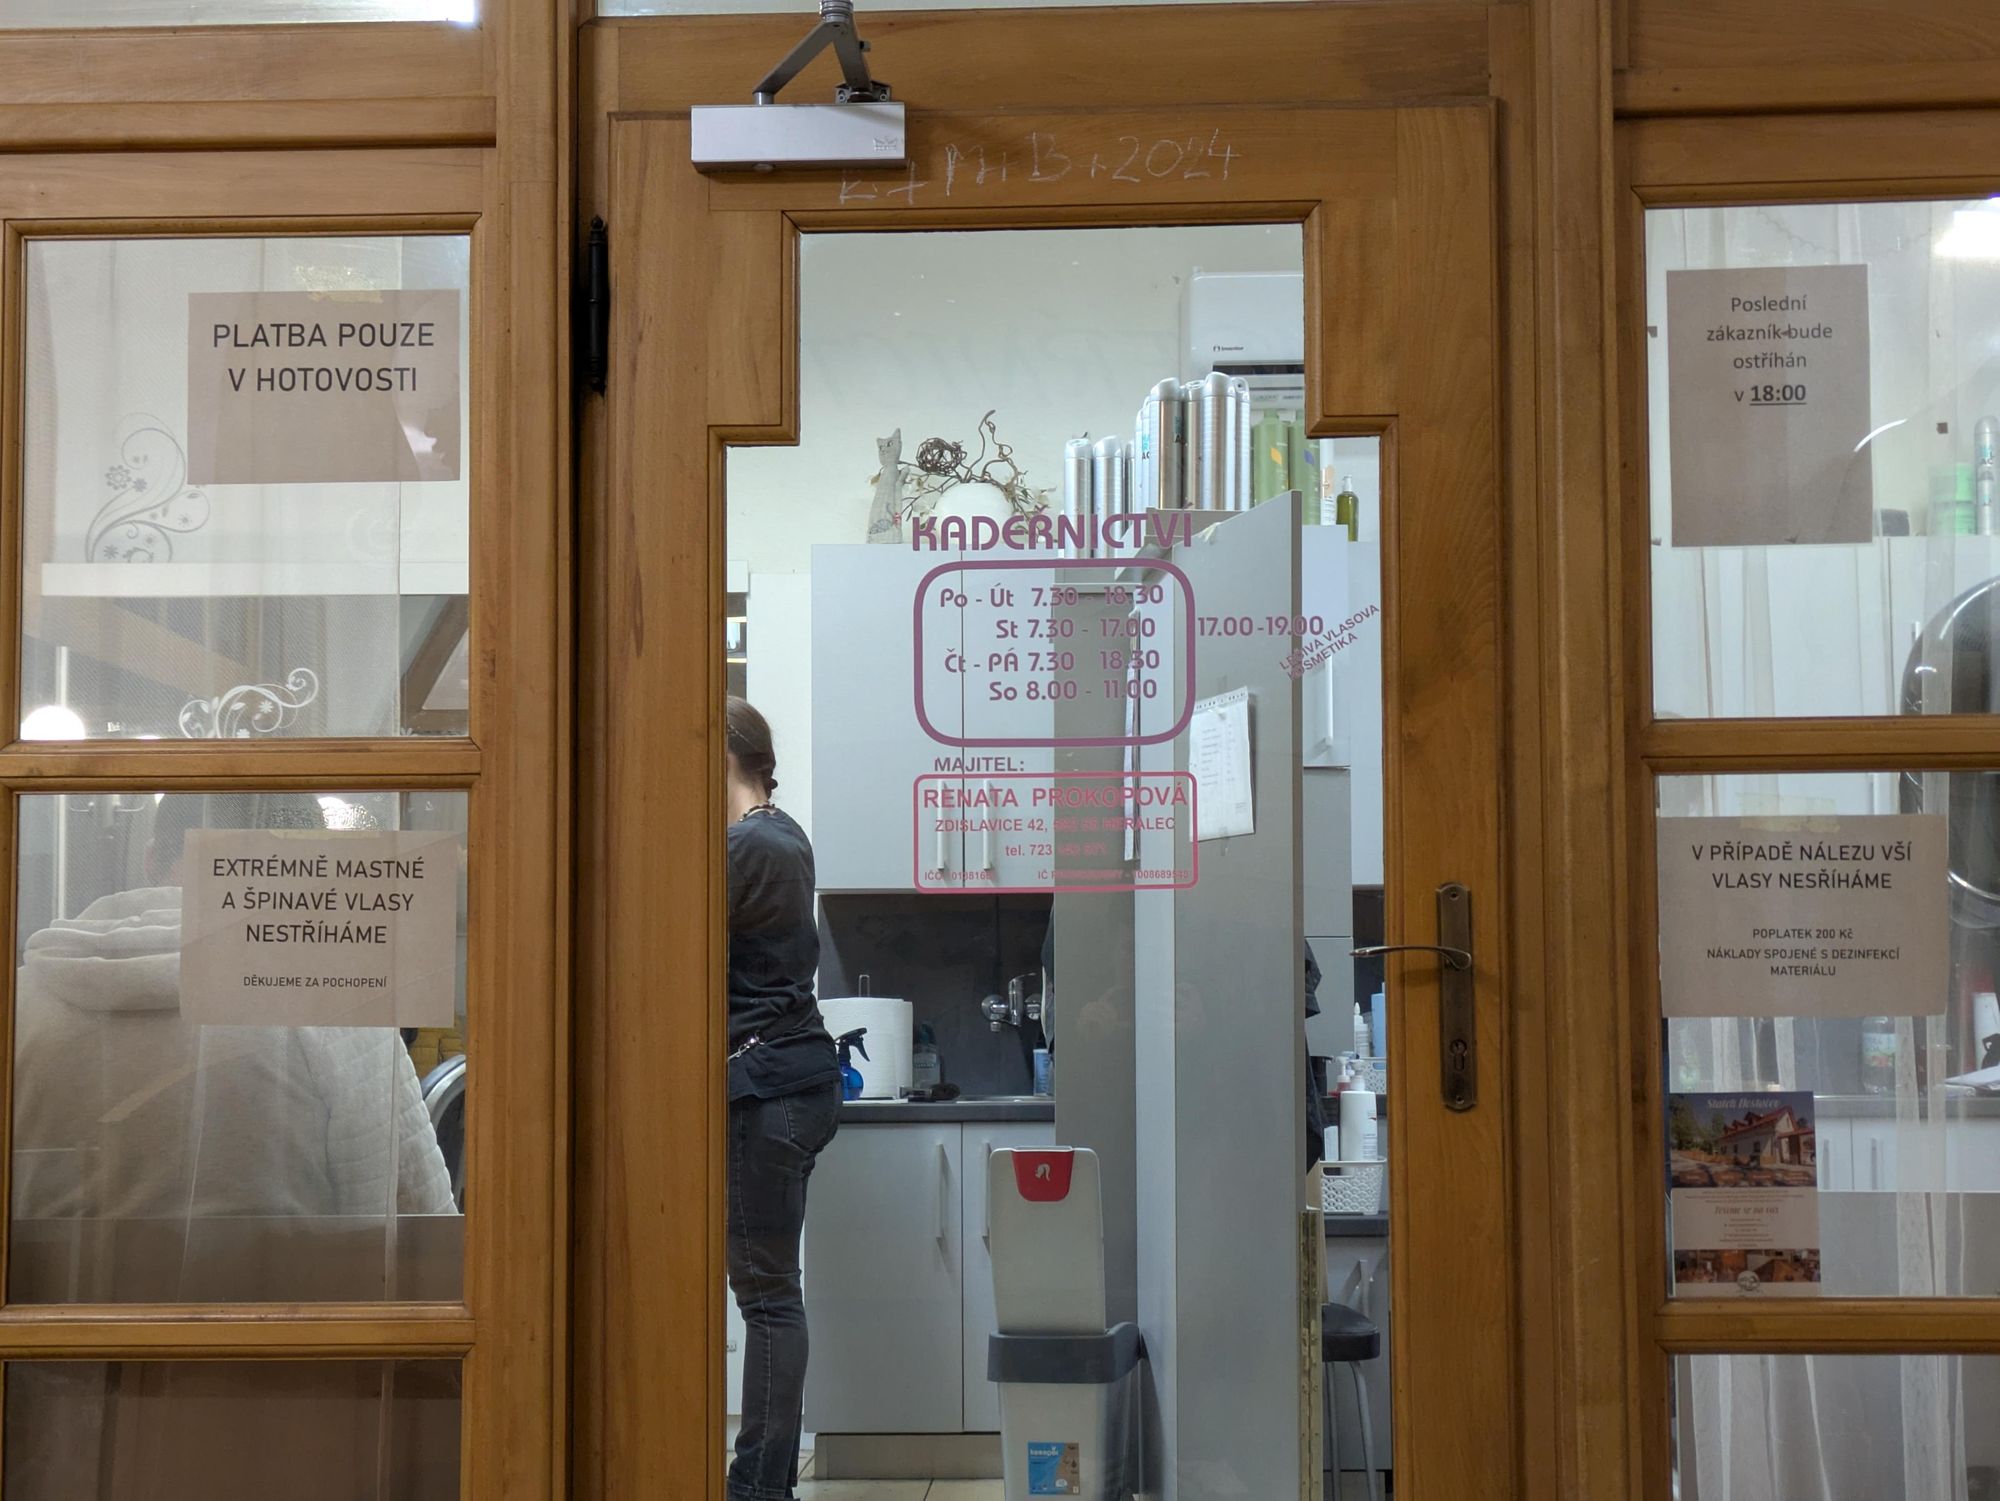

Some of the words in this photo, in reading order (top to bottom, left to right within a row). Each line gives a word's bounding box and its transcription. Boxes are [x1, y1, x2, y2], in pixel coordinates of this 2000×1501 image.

[1731, 294, 1807, 313] Poslední
[213, 322, 328, 348] PLATBA
[338, 322, 435, 348] POUZE
[1706, 323, 1782, 342] zákazník
[1787, 322, 1833, 340] bude
[1733, 351, 1807, 369] ostříhán
[227, 367, 246, 392] V
[256, 367, 417, 392] HOTOVOSTI
[1734, 390, 1744, 402] v
[1750, 384, 1806, 403] 18:00
[940, 588, 968, 608] Po
[989, 582, 1015, 608] Út
[1031, 585, 1079, 607] 7.30
[996, 619, 1018, 639] St
[1026, 618, 1075, 639] 7.30
[1100, 617, 1156, 638] 17.00
[944, 648, 967, 673] Čt
[988, 647, 1018, 673] PÁ
[1027, 651, 1075, 672] 7.30
[1099, 649, 1160, 670] 1830
[989, 681, 1018, 701] So
[1026, 680, 1077, 701] 8.00
[1103, 679, 1158, 700] 11.00
[933, 756, 1025, 772] MAJITEL:
[923, 788, 1020, 808] RENATA
[1032, 782, 1189, 808] PROKOPOVÁ
[935, 818, 1023, 832] ZDISLAVICE
[1027, 818, 1048, 834] 42,
[1005, 844, 1025, 856] tel.
[1029, 844, 1053, 856] 723
[1691, 844, 1704, 861] V
[1710, 840, 1793, 861] PŘÍPADĚ
[1799, 840, 1875, 861] NÁLEZU
[1881, 840, 1913, 862] VŠÍ
[213, 854, 329, 878] EXTRÉMNĚ
[336, 855, 425, 879] MASTNÉ
[1711, 872, 1773, 889] VLASY
[1778, 868, 1892, 889] NESŘÍHÁME
[221, 891, 236, 910] A
[243, 886, 338, 911] ŠPINAVÉ
[344, 892, 414, 912] VLASY
[246, 919, 387, 944] NESTŘÍHÁME
[1752, 928, 1813, 940] POPLATEK
[1815, 928, 1836, 940] 200
[1706, 946, 1761, 960] NÁKLADY
[1763, 946, 1817, 960] SPOJENÉ
[1820, 948, 1829, 960] S
[1831, 946, 1900, 960] DEZINFEKCÍ
[1770, 963, 1836, 977] MATERIÁLU
[243, 974, 302, 988] DĚKUJEME
[304, 976, 320, 988] ZA
[322, 975, 388, 988] POCHOPENÍ
